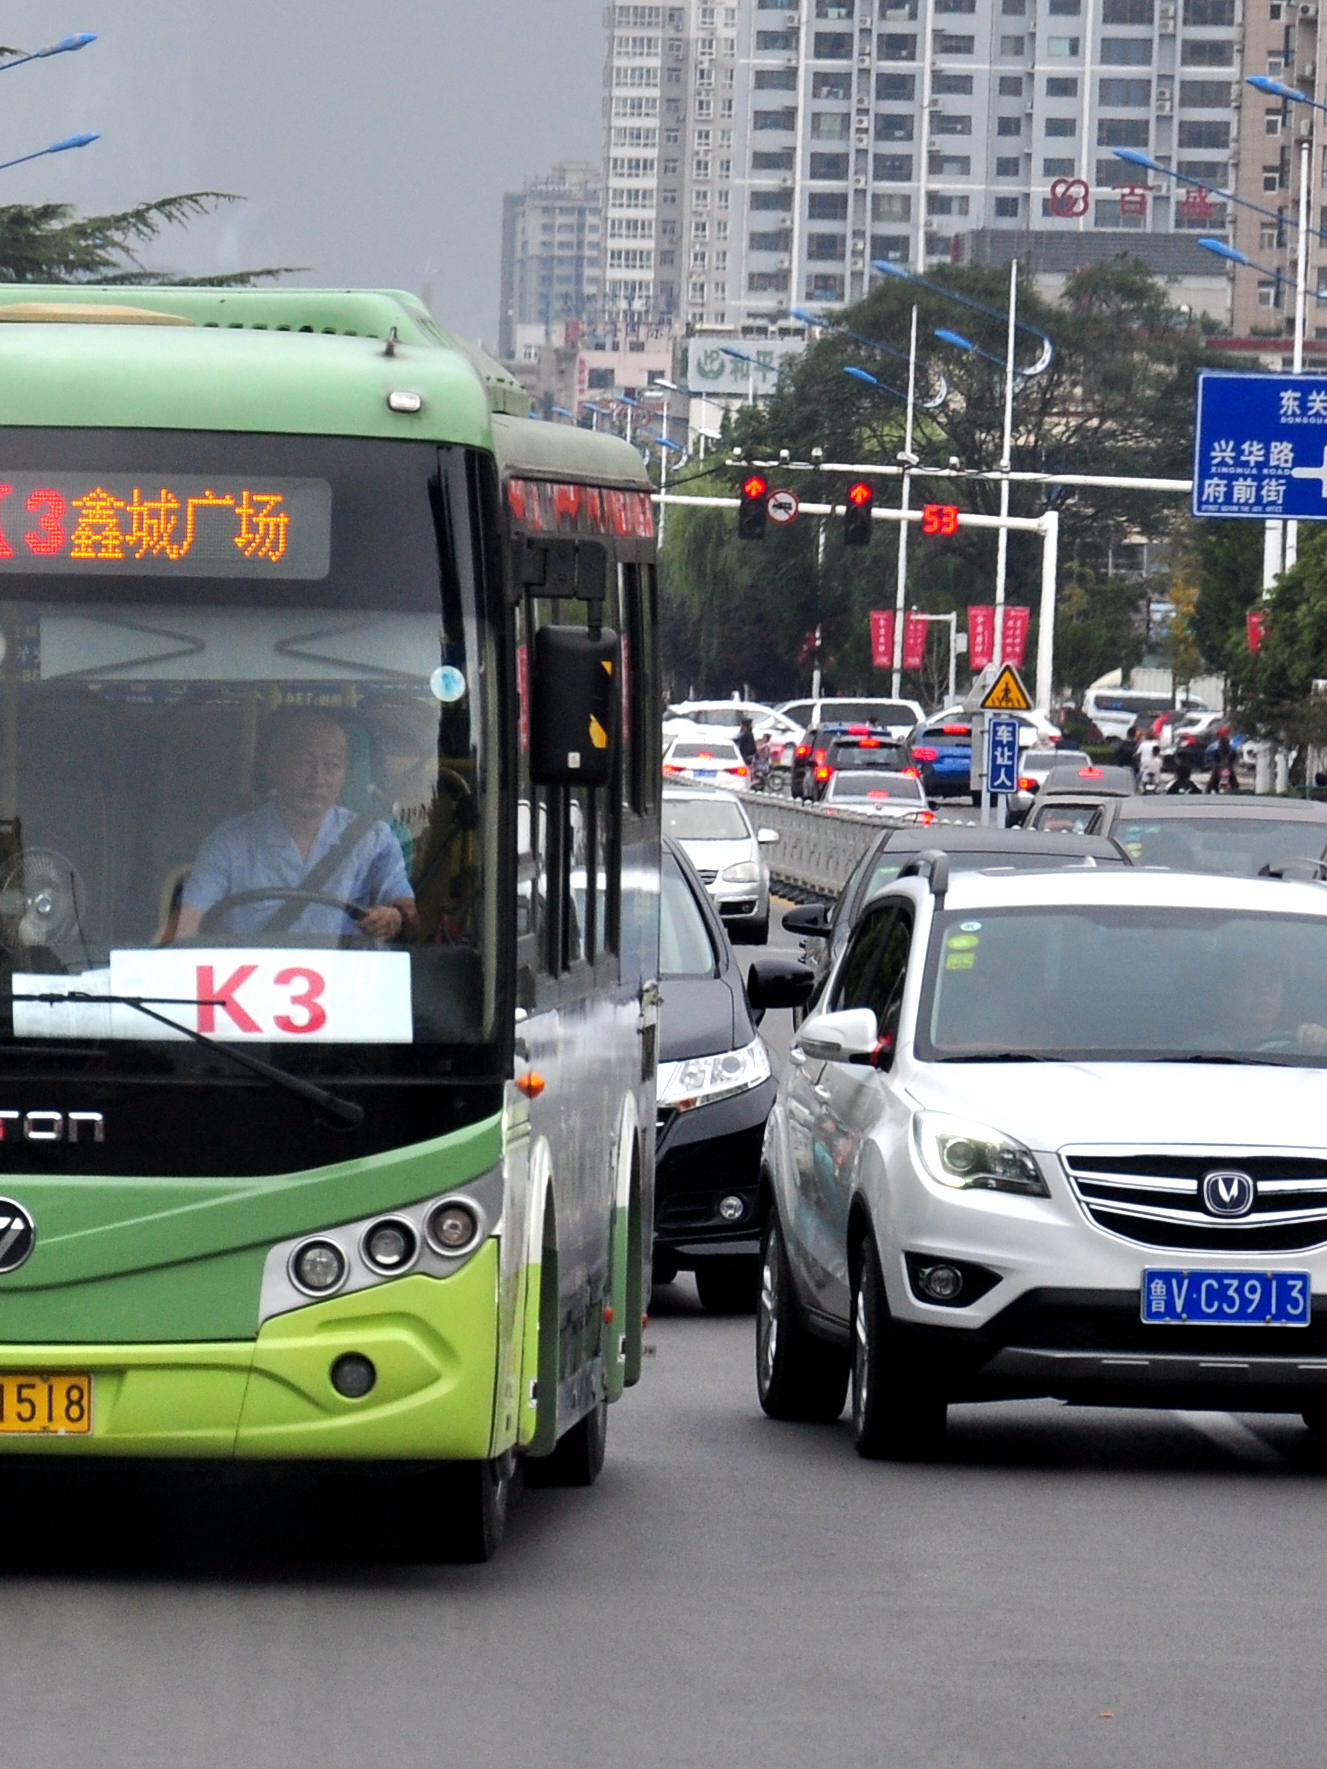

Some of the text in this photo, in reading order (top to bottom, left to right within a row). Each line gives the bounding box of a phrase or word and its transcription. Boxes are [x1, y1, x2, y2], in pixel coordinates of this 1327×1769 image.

[1210, 439, 1294, 467] 兴华路
[1210, 467, 1291, 476] XINGHUA ROAD
[1202, 476, 1287, 504] 府前街
[70, 487, 289, 562] 鑫城广场
[923, 503, 960, 535] 53
[993, 724, 1014, 787] 车让人
[195, 964, 328, 1034] K3
